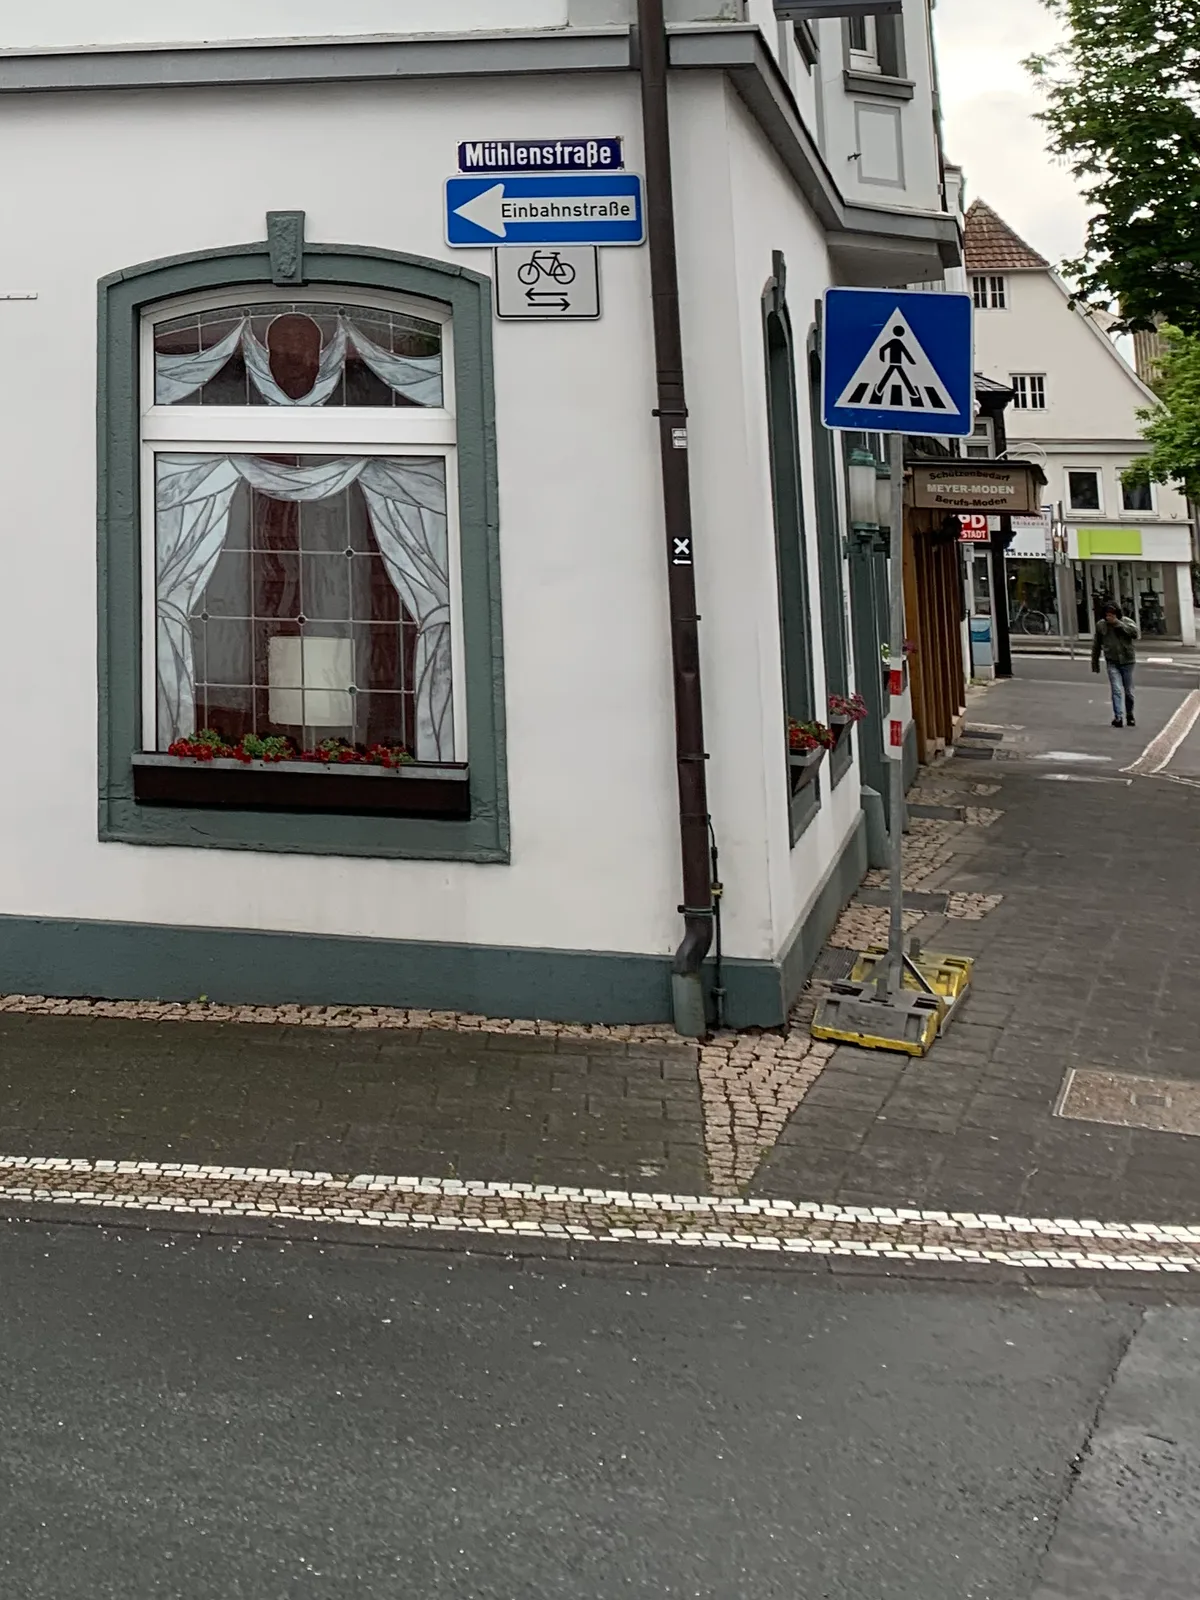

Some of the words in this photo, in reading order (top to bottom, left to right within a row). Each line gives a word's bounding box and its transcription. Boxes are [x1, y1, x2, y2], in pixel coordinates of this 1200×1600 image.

[465, 141, 612, 168] Mühlenstraße
[502, 201, 630, 218] Einbahnstraße
[927, 484, 1015, 495] MEYER-MODEN
[935, 495, 1007, 507] Berufs-Moden
[960, 530, 986, 539] STADT
